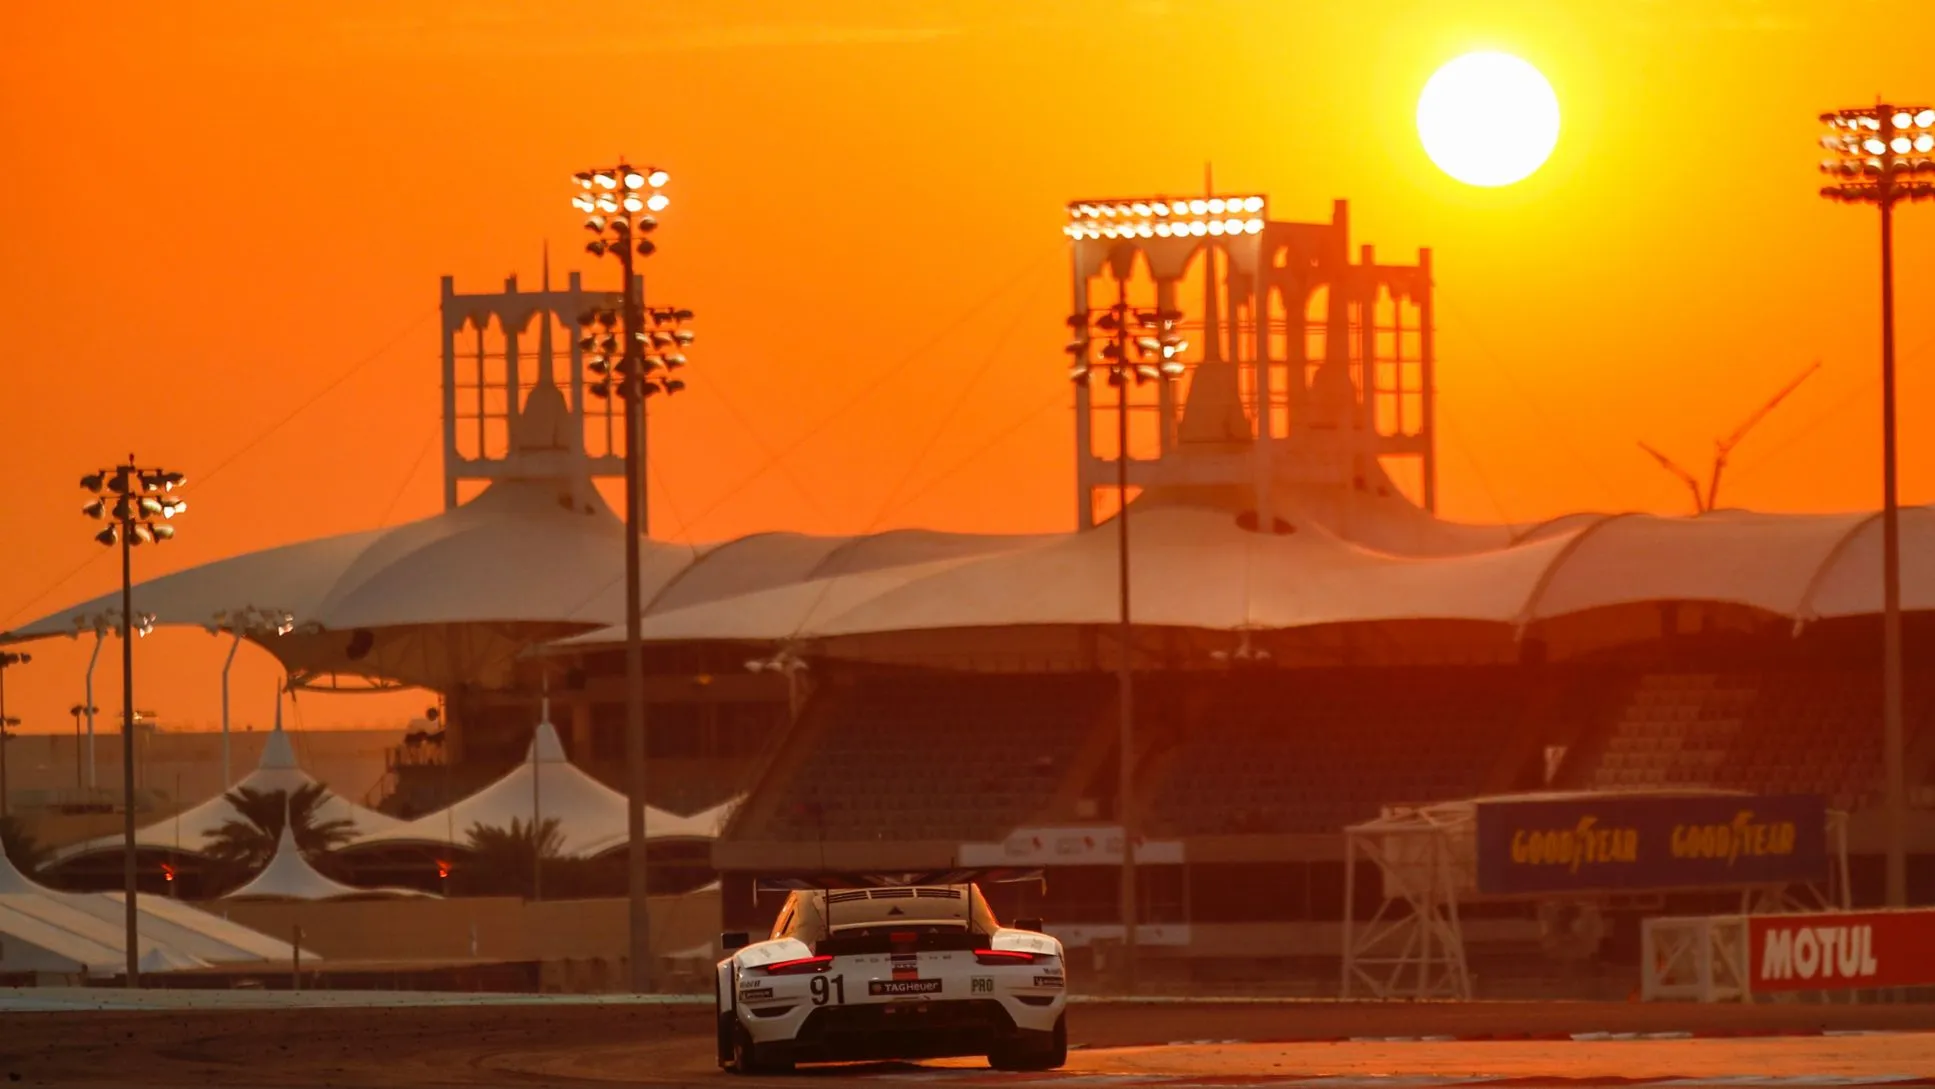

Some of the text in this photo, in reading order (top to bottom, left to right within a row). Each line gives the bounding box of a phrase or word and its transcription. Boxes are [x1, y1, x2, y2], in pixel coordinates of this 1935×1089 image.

[1512, 810, 1795, 873] GOODYEAR GOODYEAR
[1761, 925, 1878, 981] MOTUL
[810, 974, 845, 1005] 91
[972, 978, 994, 992] PRO
